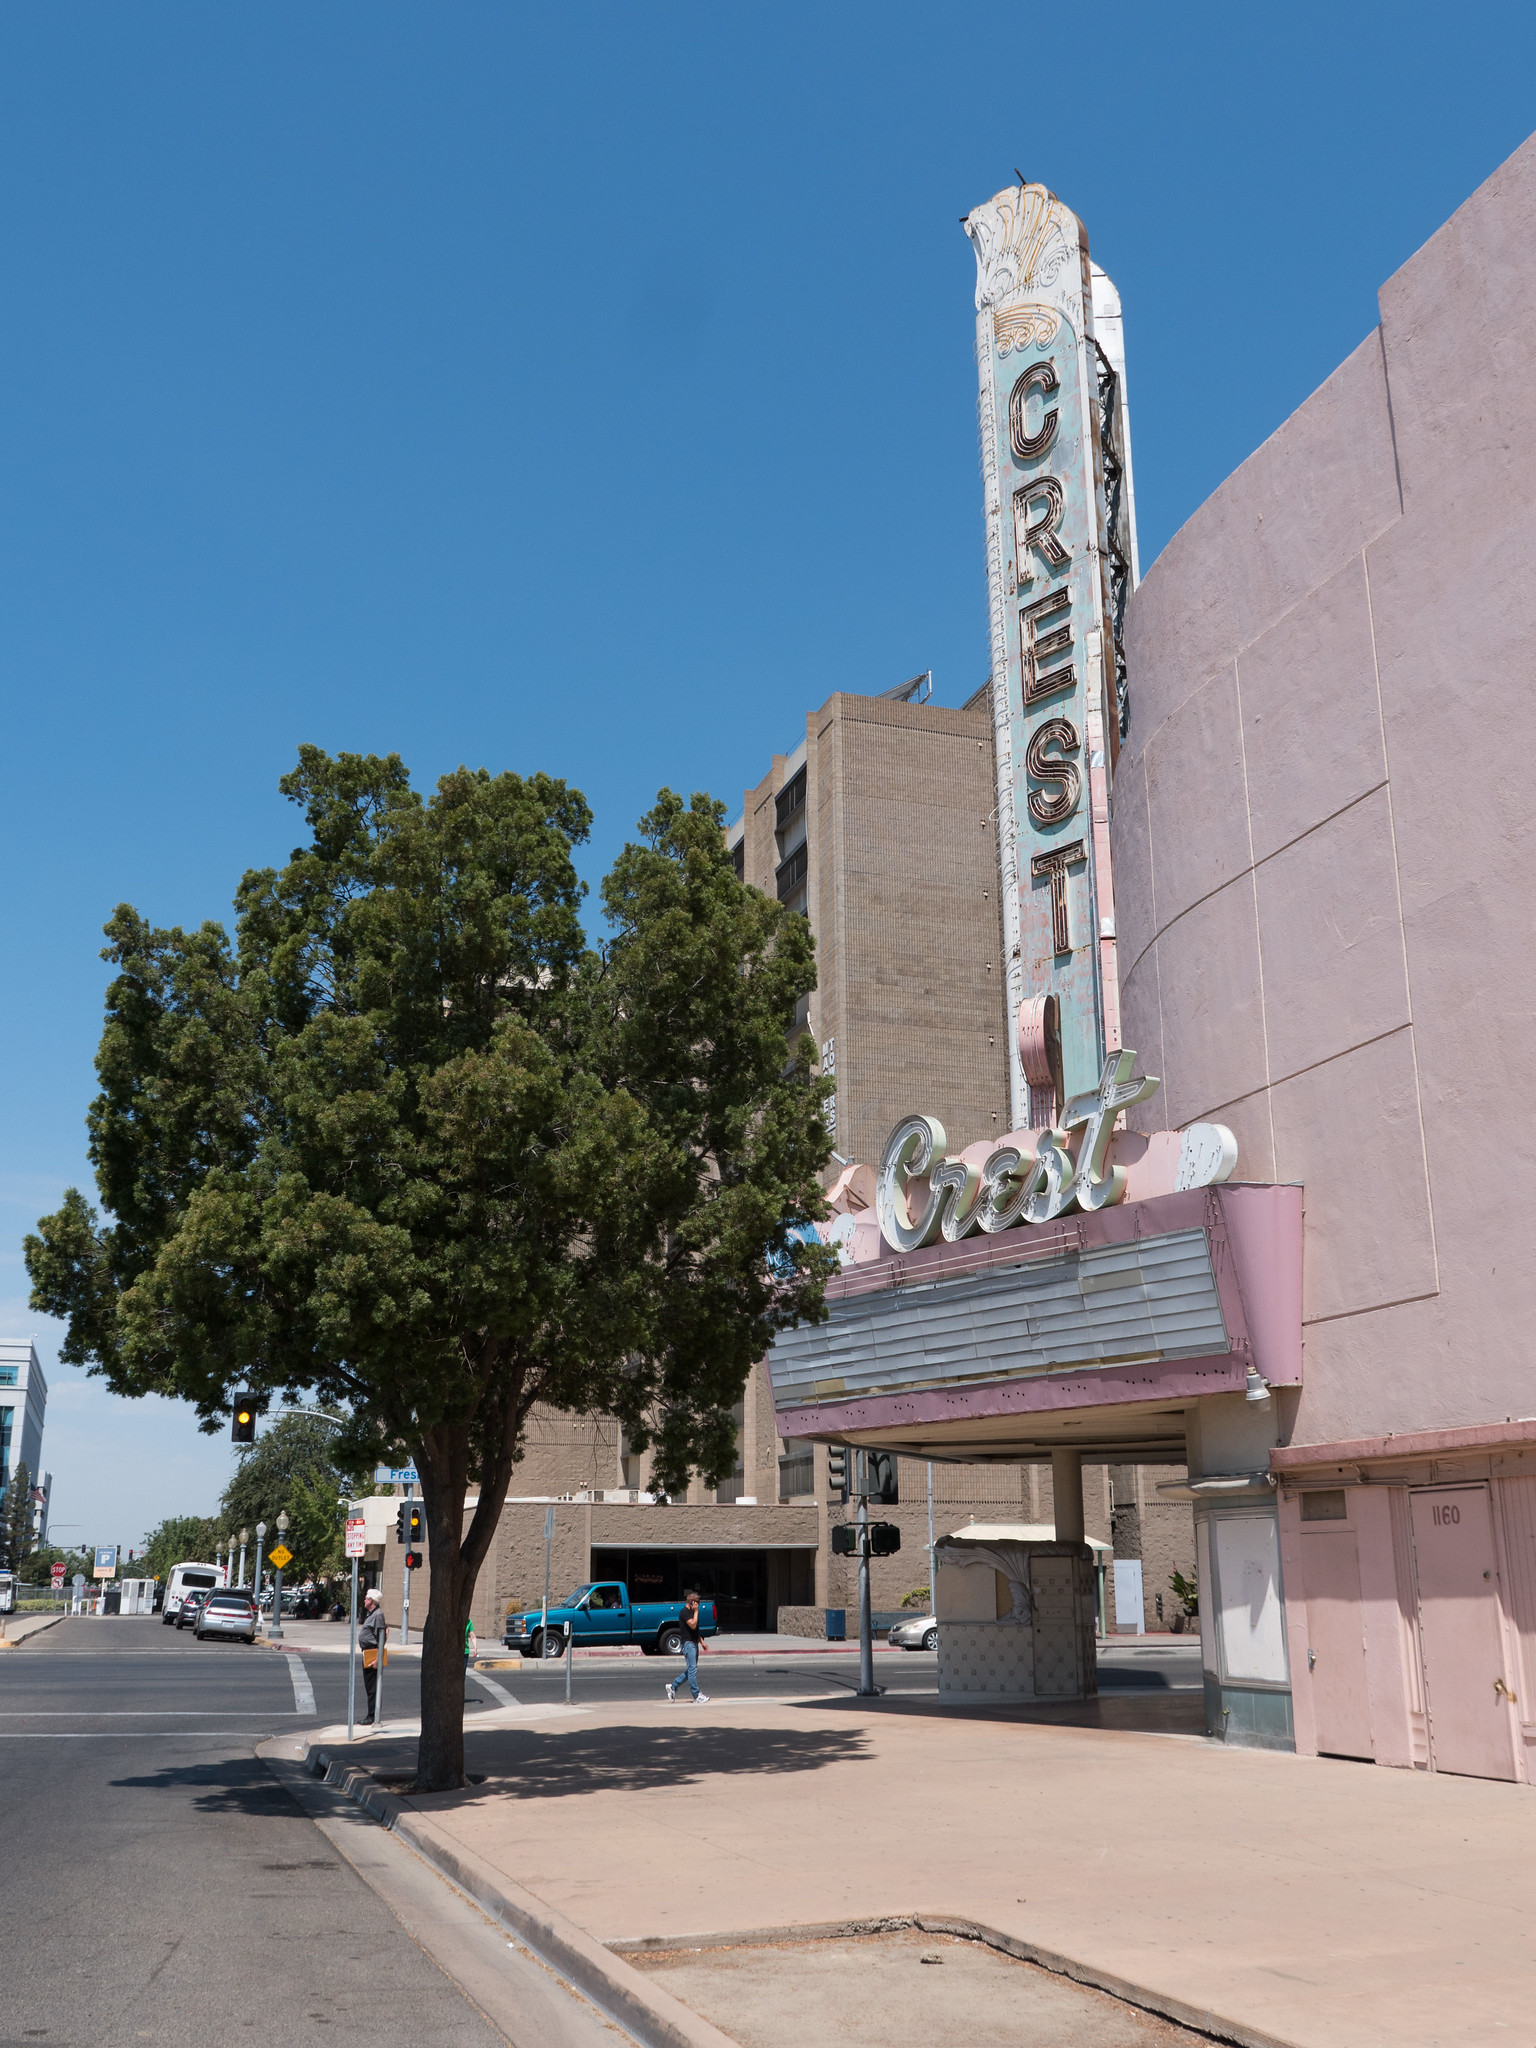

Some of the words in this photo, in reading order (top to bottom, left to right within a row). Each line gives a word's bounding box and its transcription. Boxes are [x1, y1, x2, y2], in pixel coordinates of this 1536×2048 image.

[1009, 361, 1088, 956] CREST
[876, 1048, 1160, 1254] Crest
[1432, 1504, 1460, 1526] 1160
